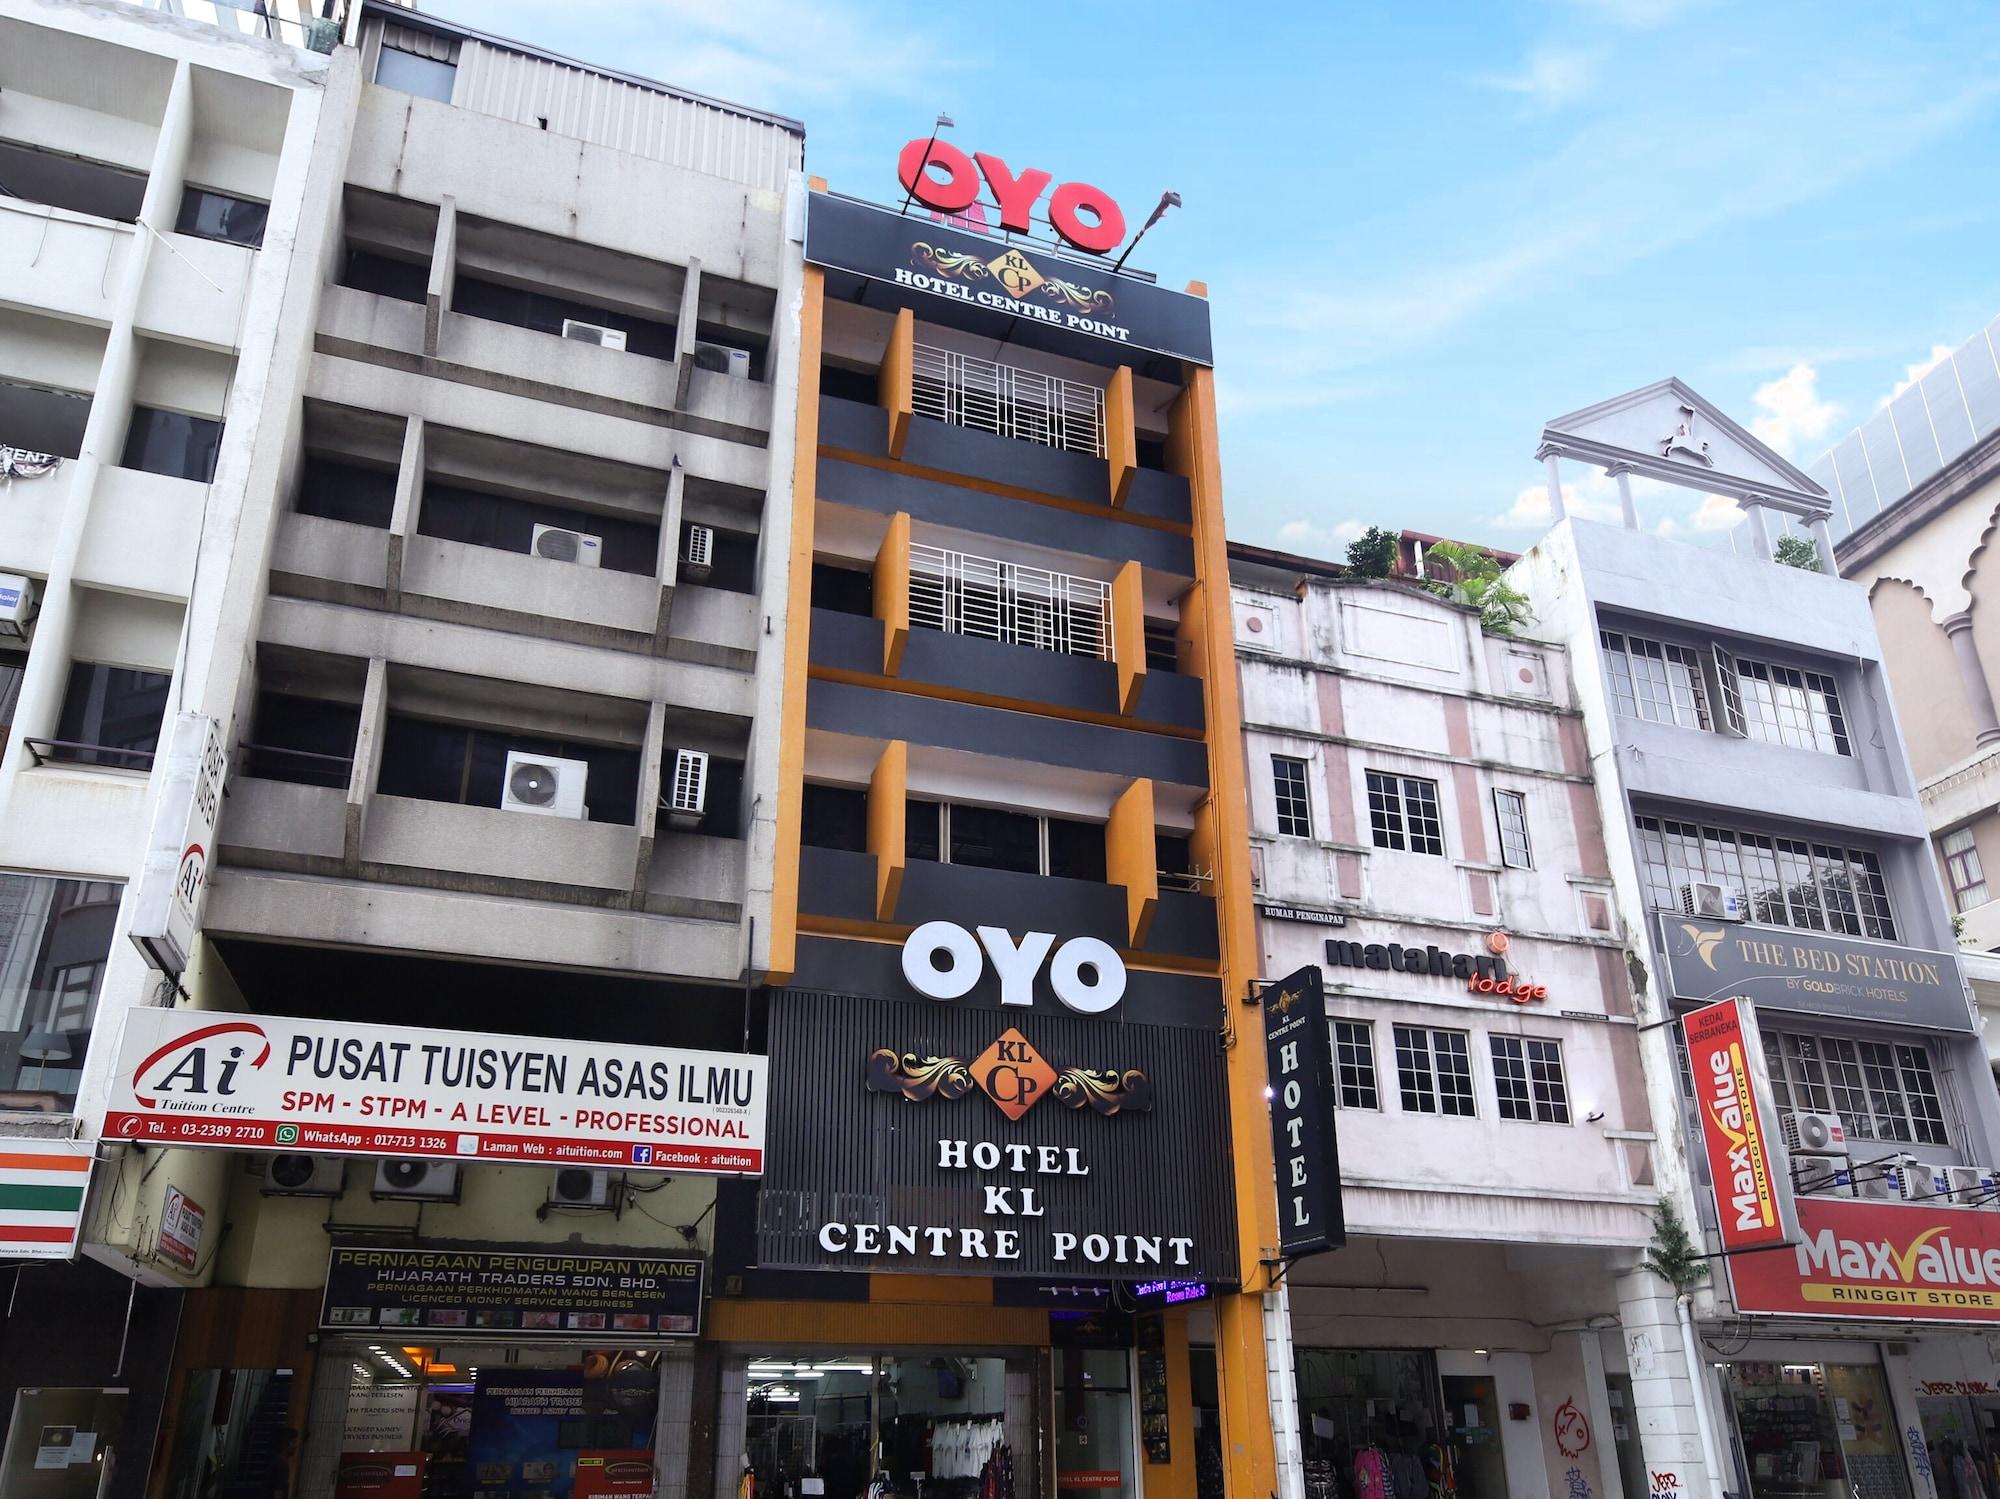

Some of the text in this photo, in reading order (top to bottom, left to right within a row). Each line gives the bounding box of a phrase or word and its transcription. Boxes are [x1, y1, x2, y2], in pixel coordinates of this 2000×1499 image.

[897, 138, 1126, 255] OYO
[1005, 254, 1028, 271] KL
[998, 266, 1031, 293] CP
[894, 267, 1130, 341] HOTEL CENTRE POINT
[181, 859, 199, 903] Ai
[1264, 907, 1344, 924] RUMAH PENGINAPAN
[901, 920, 1127, 1014] OYO
[1325, 932, 1508, 981] matahari
[1735, 939, 1941, 987] THE BED STATION
[1468, 972, 1549, 1003] lodge
[1786, 977, 1908, 1003] BY GOLDBRICK HOTELS
[1268, 1016, 1306, 1040] CENTRE POINT
[1281, 1015, 1290, 1024] KL
[1689, 1019, 1738, 1044] SERBANEKA
[1698, 1011, 1723, 1029] KEDAI
[997, 1040, 1033, 1064] KL
[153, 1046, 245, 1095] Ai
[286, 1035, 753, 1107] PUSAT TUISYEN ASAS ILMU
[986, 1065, 1037, 1106] CP
[160, 1099, 255, 1115] Tuition Centre
[281, 1091, 335, 1113] SPM
[360, 1096, 427, 1119] STPM
[450, 1102, 467, 1122] A
[476, 1103, 551, 1126] LEVEL
[575, 1109, 750, 1139] PROFESSIONAL
[148, 1121, 167, 1134] Tel.
[181, 1123, 231, 1137] 03-2389
[236, 1126, 264, 1139] 2710
[304, 1130, 362, 1145] WhatsApp
[374, 1135, 416, 1148] 017-713
[420, 1136, 447, 1149] 1326
[1280, 1040, 1310, 1227] HOTEL
[1736, 1067, 1768, 1201] RINGGIT STORE
[483, 1141, 519, 1154] Laman
[523, 1143, 545, 1155] Web
[556, 1145, 623, 1159] aituition.com
[655, 1150, 701, 1164] Facebook
[711, 1155, 752, 1167] aituition
[938, 1139, 1090, 1175] HOTEL
[983, 1185, 1045, 1217] KL
[818, 1222, 1194, 1266] CENTRE POINT
[338, 1252, 697, 1277] PERNIAGAAN PENGURUPAN WANG
[367, 1283, 667, 1300] PERNIAGAAN PERKHIDMATAN WANG BERLESEN
[377, 1269, 472, 1284] HIJARATH
[480, 1272, 567, 1287] TRADERS
[572, 1275, 613, 1288] SDN.
[619, 1277, 660, 1289] BHD.
[401, 1294, 635, 1309] LICENCED MONEY SERVICES BUSINESS
[1832, 1287, 1994, 1306] RINGGIT STORE
